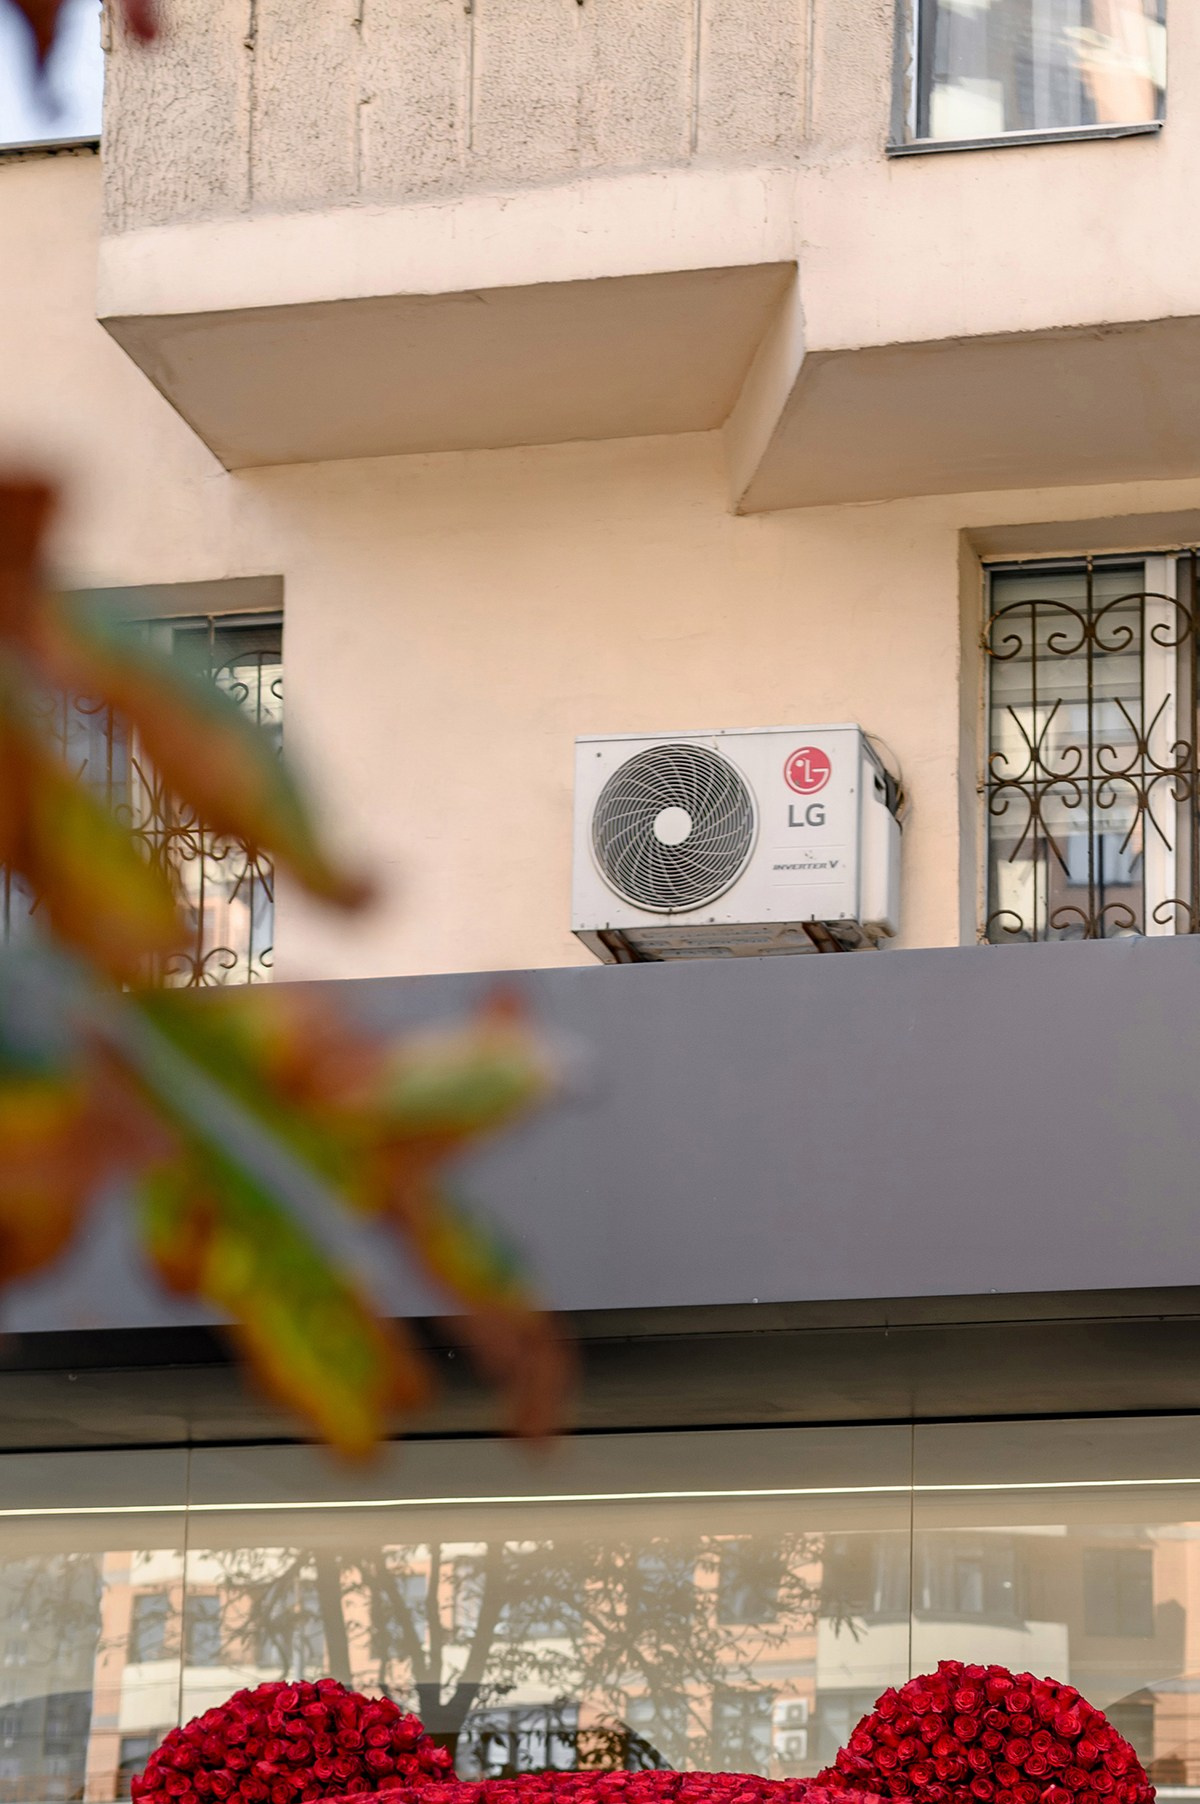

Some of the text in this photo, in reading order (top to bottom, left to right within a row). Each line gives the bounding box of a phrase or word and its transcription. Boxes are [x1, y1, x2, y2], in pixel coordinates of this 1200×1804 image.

[788, 803, 826, 828] LG
[772, 860, 839, 871] INVERTER V
